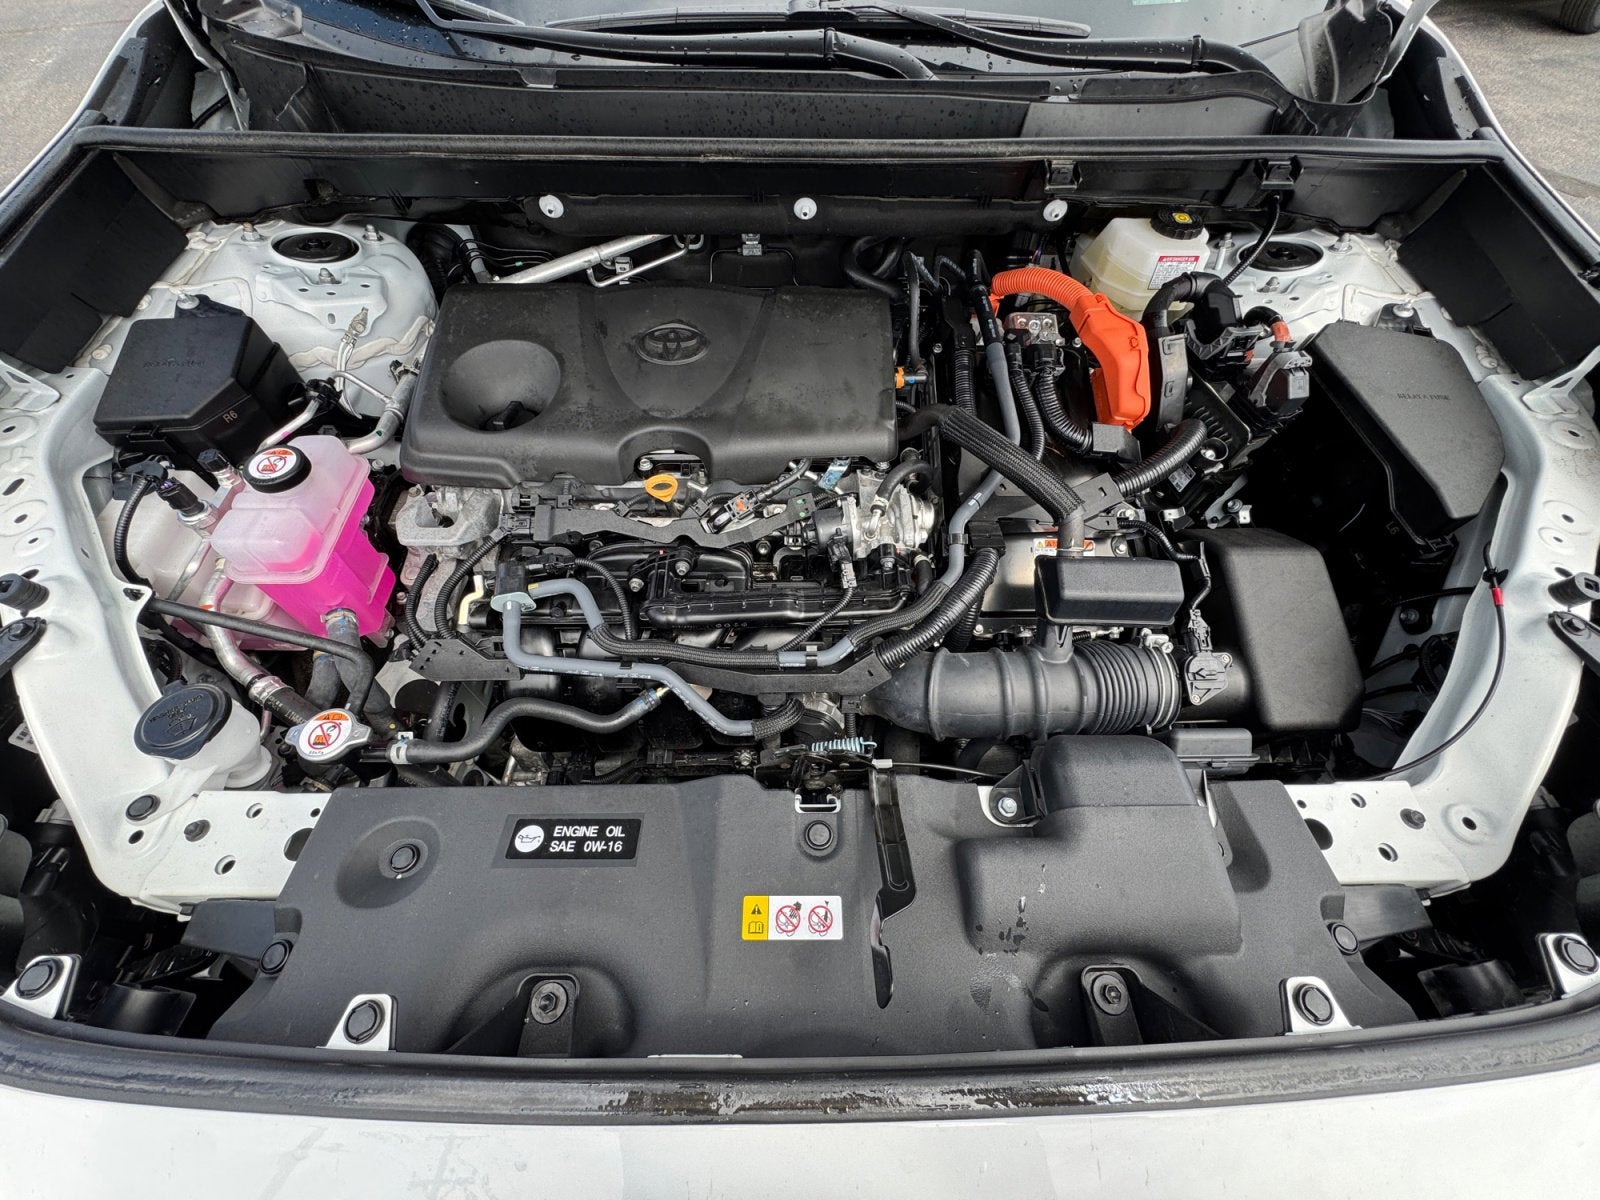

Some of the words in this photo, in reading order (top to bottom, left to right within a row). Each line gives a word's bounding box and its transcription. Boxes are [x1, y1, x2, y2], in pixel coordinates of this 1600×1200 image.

[222, 410, 238, 424] R6
[1386, 521, 1399, 535] L6
[553, 825, 599, 837] ENGINE
[605, 826, 625, 837] OIL
[549, 840, 575, 852] SAE
[583, 840, 623, 852] 0W-16
